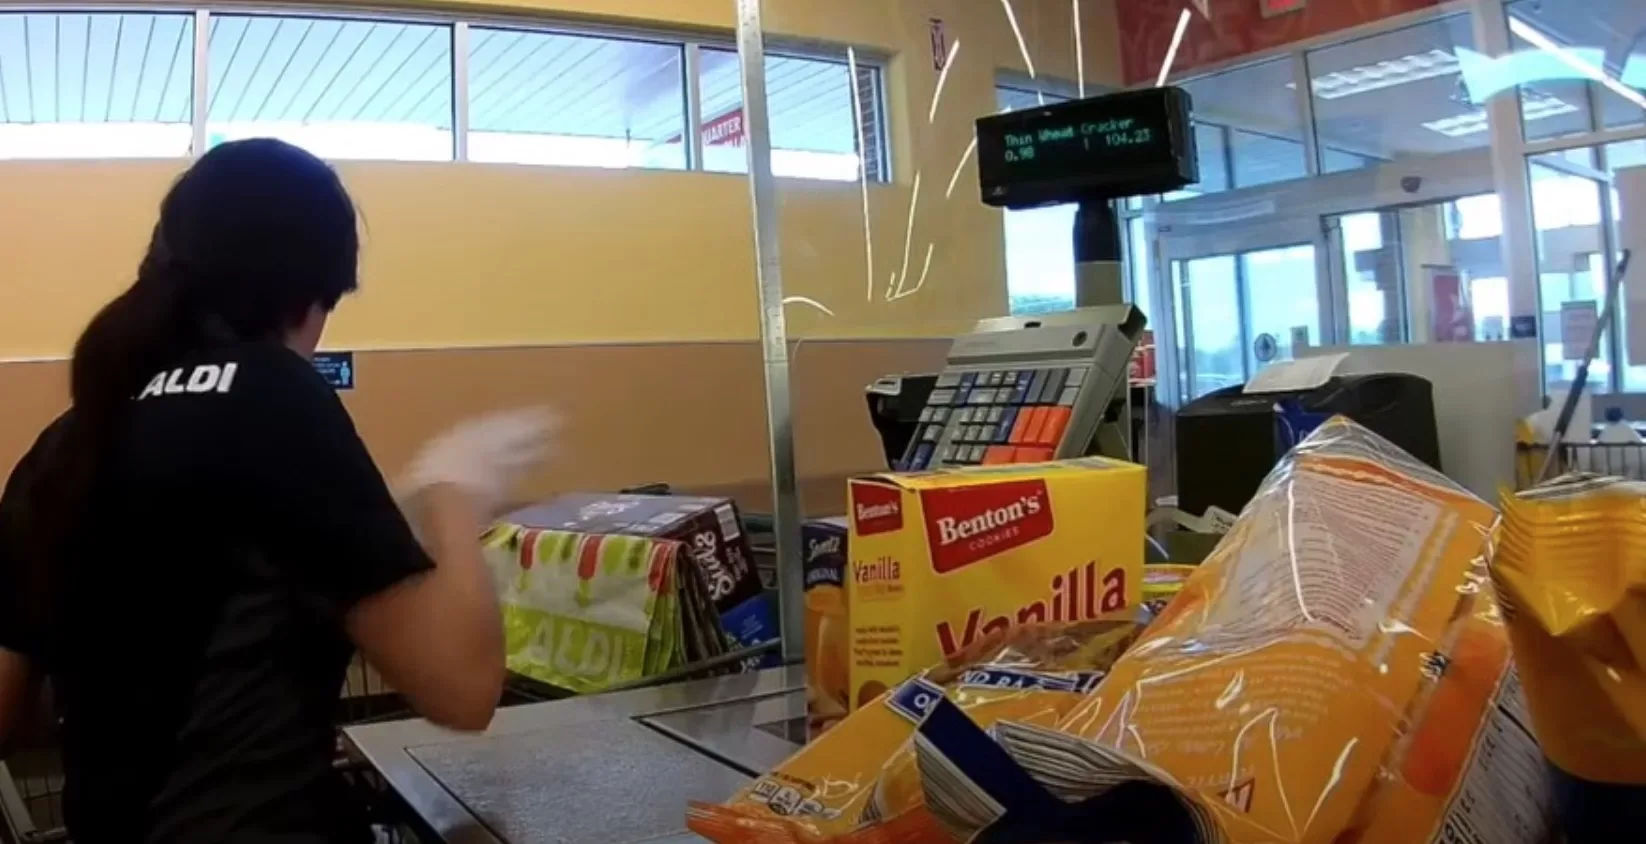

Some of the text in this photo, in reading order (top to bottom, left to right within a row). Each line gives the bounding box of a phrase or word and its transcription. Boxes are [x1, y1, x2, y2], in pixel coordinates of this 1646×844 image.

[1004, 132, 1033, 147] Thin
[1080, 117, 1135, 134] Cracker
[138, 362, 239, 401] ALDI
[936, 493, 1042, 546] Benton's
[968, 525, 1020, 551] COOKIES
[852, 555, 901, 583] Vanilla
[529, 615, 624, 684] ALDI
